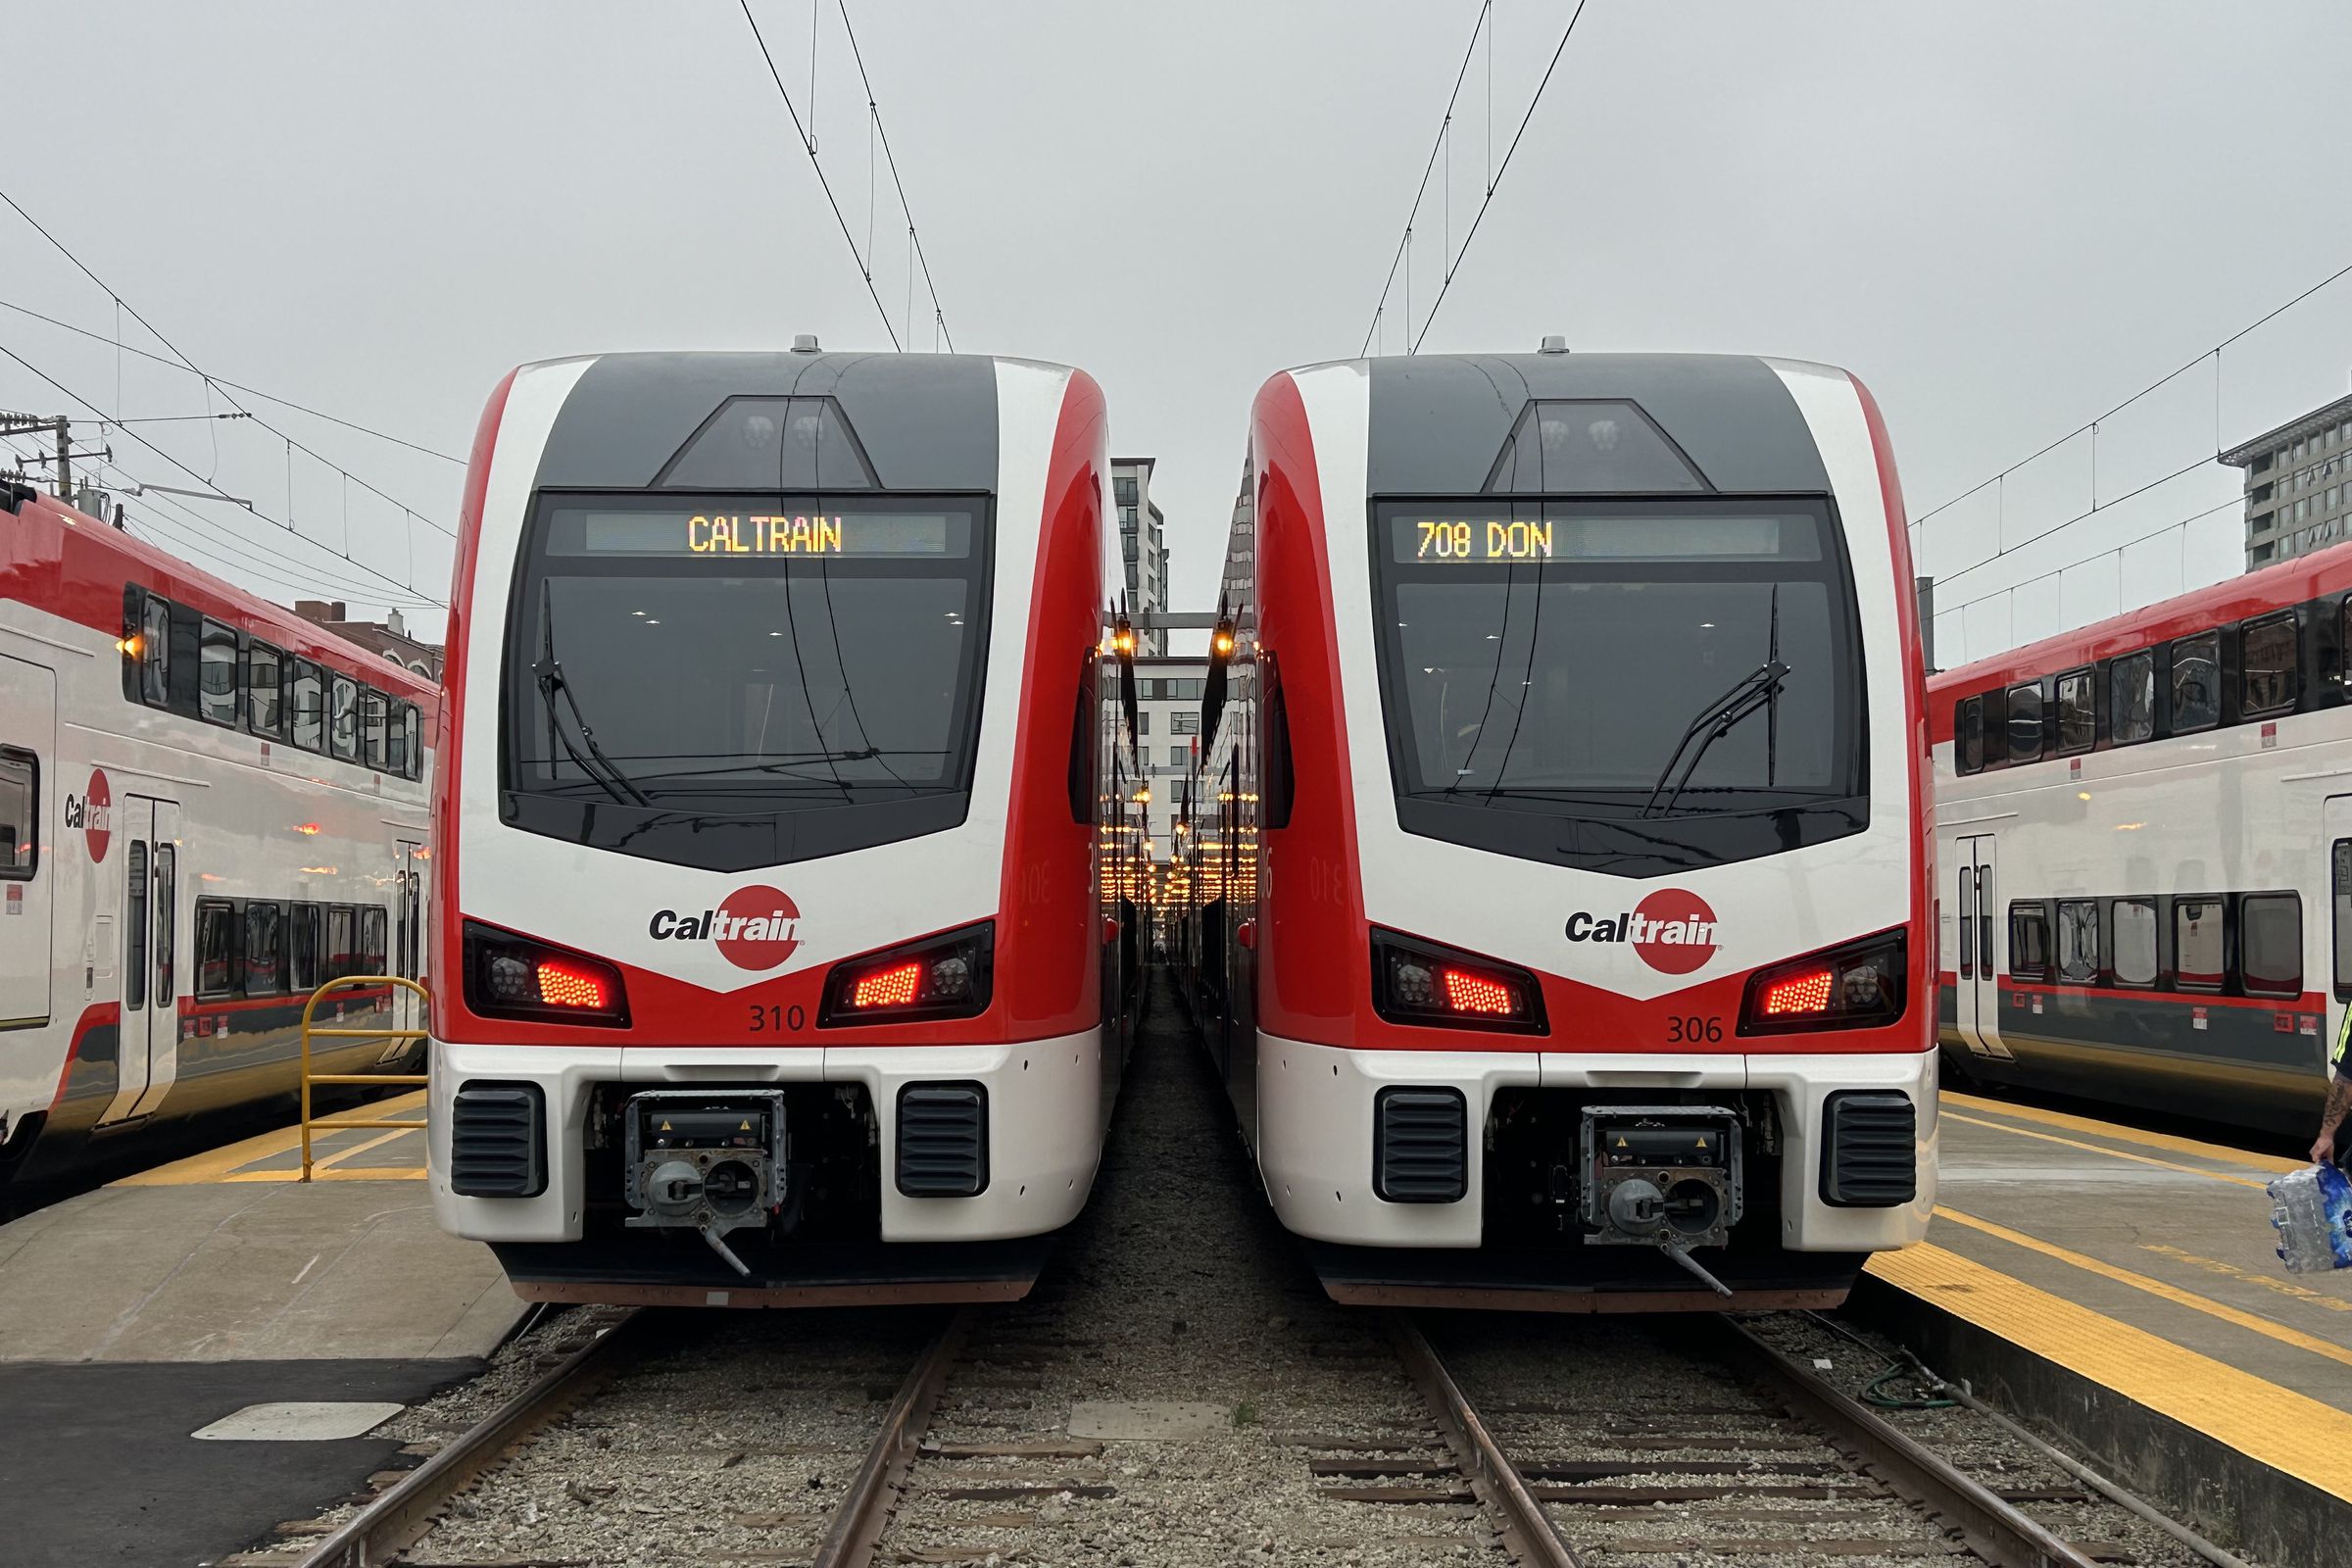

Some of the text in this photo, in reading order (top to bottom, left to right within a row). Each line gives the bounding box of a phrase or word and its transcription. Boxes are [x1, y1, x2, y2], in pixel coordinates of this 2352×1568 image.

[689, 515, 842, 553] CALTRAIN
[1417, 521, 1552, 558] 708 DON
[65, 793, 111, 831] Caltrain
[649, 909, 801, 942] Caltrain
[1565, 911, 1719, 946] Caltrain
[749, 1004, 806, 1032] 310
[1667, 1015, 1723, 1043] 306
